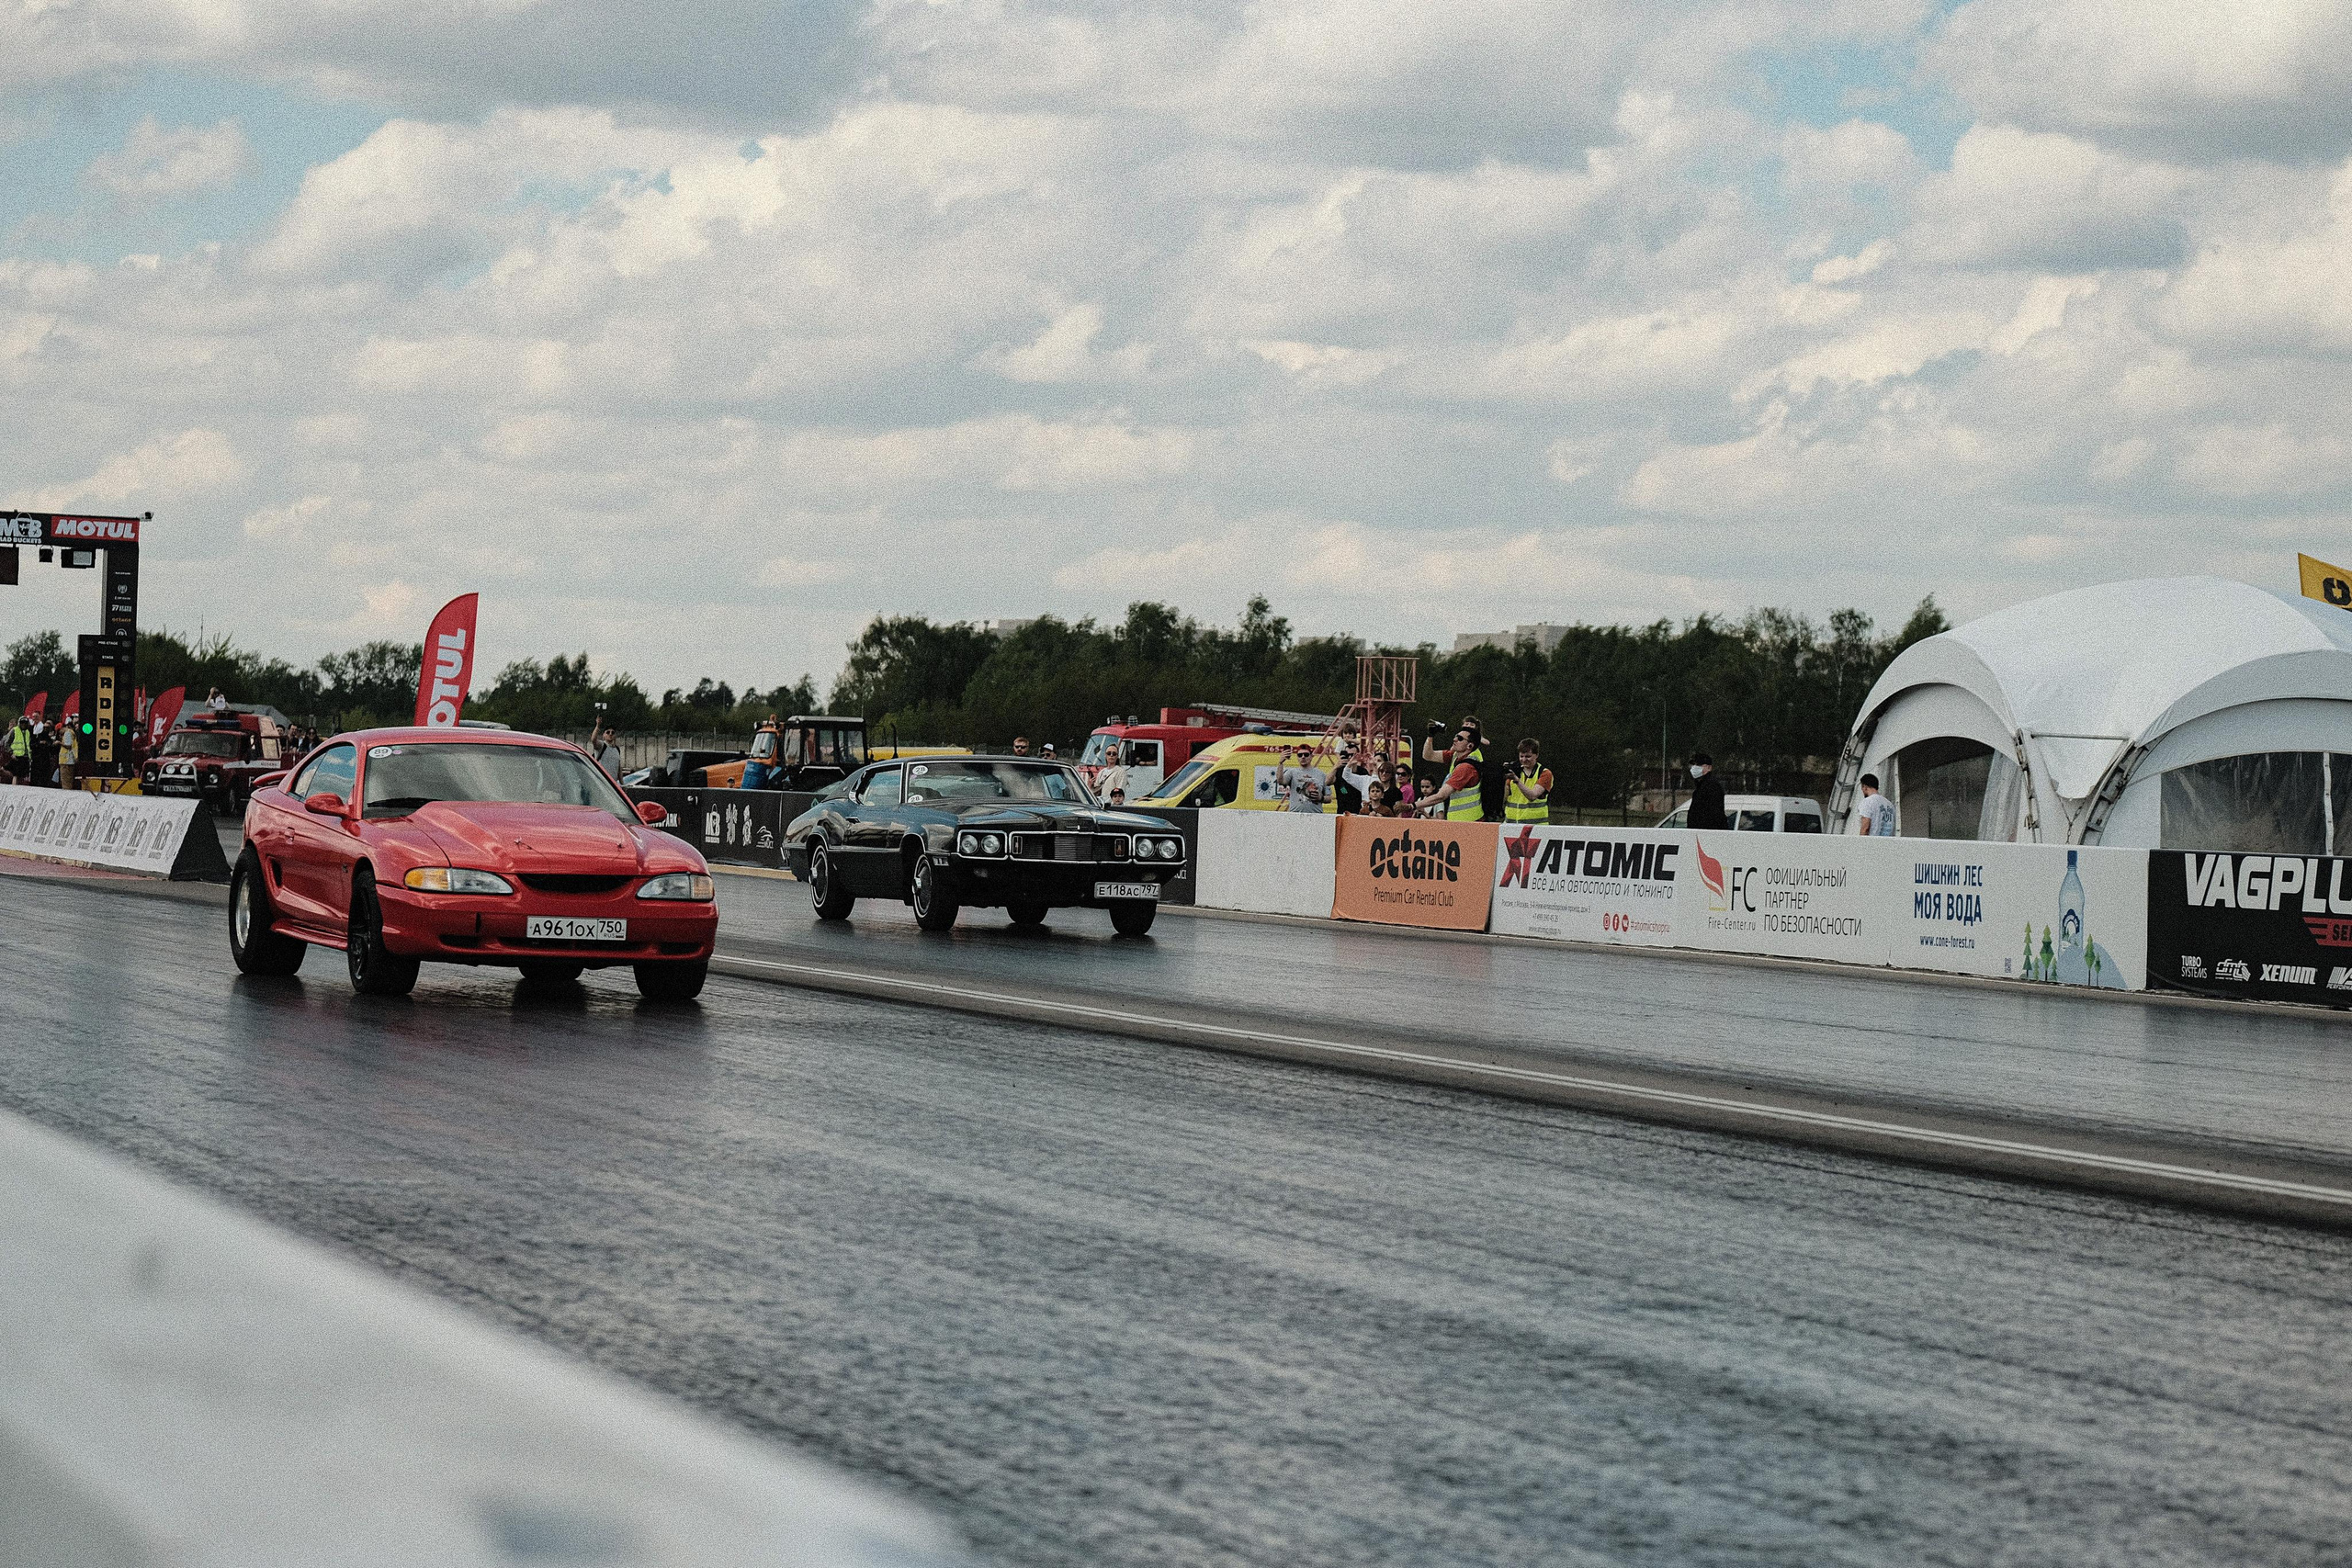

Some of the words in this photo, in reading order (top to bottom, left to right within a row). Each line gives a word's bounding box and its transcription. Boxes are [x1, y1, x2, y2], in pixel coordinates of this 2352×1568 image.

[55, 519, 135, 539] MOTUL
[427, 627, 467, 727] OTUL
[1370, 829, 1461, 883] octane
[1536, 839, 1679, 882] ATOMIC
[1765, 866, 1847, 888] ОФИЦИАЛЬНЫЙ
[1915, 863, 1960, 885] ШИШКИН
[1963, 865, 1983, 886] ЛЕС
[1142, 885, 1157, 894] 797
[1374, 886, 1403, 903] Premium
[1404, 888, 1416, 904] Car
[1416, 889, 1437, 906] Rental
[1438, 891, 1453, 907] Club
[1623, 884, 1630, 896] и
[1731, 866, 1758, 912] FC
[1764, 891, 1810, 909] ПАРТНЕР
[1914, 892, 1941, 920] МОЯ
[1946, 893, 1982, 927] ВОДА
[599, 921, 622, 933] 750
[1708, 916, 1757, 931] Fire-Center.ru
[1763, 914, 1779, 931] ПО
[1781, 915, 1862, 936] БЕЗОПАСНОСТИ
[2181, 955, 2202, 967] TURBO
[2181, 966, 2208, 979] SYSTEMS
[2260, 964, 2316, 985] XENUM
